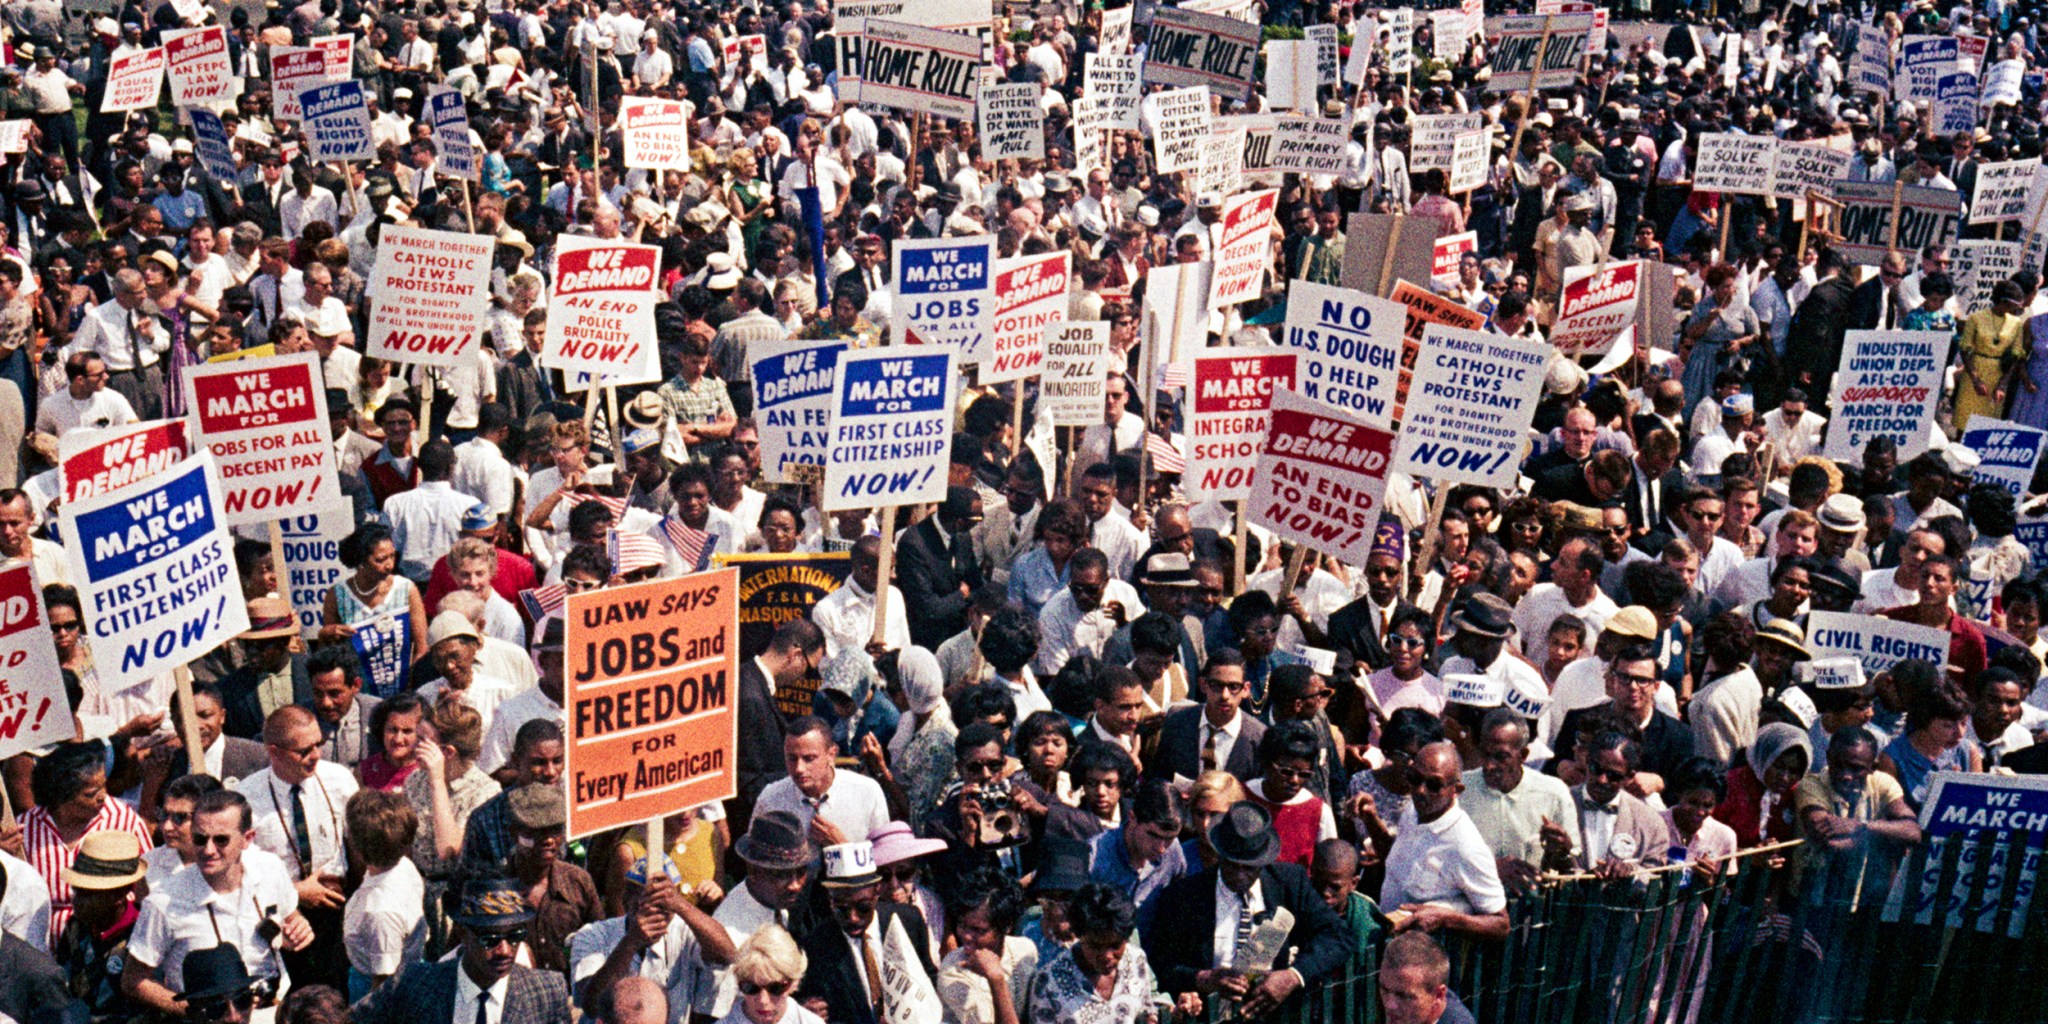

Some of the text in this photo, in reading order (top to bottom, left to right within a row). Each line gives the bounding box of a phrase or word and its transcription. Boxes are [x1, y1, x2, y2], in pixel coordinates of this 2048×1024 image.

[183, 32, 204, 45] WE
[171, 39, 223, 64] DEMAND
[1148, 23, 1254, 81] HOME RULE
[174, 61, 226, 75] AN FEPC
[863, 39, 980, 99] HOME RULE
[187, 73, 219, 83] LAW
[183, 83, 228, 98] NOW!
[318, 86, 341, 99] WE
[983, 88, 1032, 100] FIRST CLASS
[307, 93, 361, 114] DEMAND
[643, 103, 665, 117] WE
[989, 99, 1036, 109] CITIZENS
[314, 117, 361, 128] EQUAL
[629, 113, 682, 127] DEMAND
[986, 110, 1031, 121] CAN VOTE
[316, 128, 366, 141] RIGHTS
[987, 120, 1039, 132] DC WANTS
[1278, 122, 1342, 134] HOME RULE
[634, 130, 681, 142] AN END
[990, 130, 1026, 146] HOME
[320, 141, 369, 155] NOW!
[634, 141, 681, 152] TO BIAS
[1000, 140, 1031, 155] RULE
[1279, 140, 1342, 154] PRIMARY
[1713, 150, 1759, 162] SOLVE
[635, 151, 681, 163] NOW!
[1272, 156, 1342, 170] CIVIL RIGHT
[1717, 163, 1768, 176] PROBLEMS
[1222, 208, 1271, 245] DEMAND
[384, 234, 488, 255] WE MARCH TOGETHER
[1225, 242, 1262, 260] DECENT
[394, 252, 474, 271] CATHOLIC
[589, 250, 626, 269] WE
[932, 249, 959, 264] WE
[408, 267, 456, 281] JEWS
[559, 266, 650, 291] DEMAND
[905, 263, 983, 282] MARCH
[1218, 260, 1262, 279] HOUSING
[386, 277, 475, 296] PROTESTANT
[929, 283, 959, 292] FOR
[1216, 272, 1259, 298] NOW!
[399, 296, 460, 308] FOR DIGNITY
[565, 297, 637, 314] AN END
[908, 299, 980, 320] JOBS
[380, 305, 474, 321] AND BROTHERHOOD
[578, 315, 622, 330] POLICE
[1321, 299, 1372, 331] NO
[376, 316, 476, 332] OF ALL MEN UNDER GOD
[384, 330, 471, 355] NOW!
[564, 325, 630, 344] BRUTALITY
[1059, 328, 1094, 342] JOB
[559, 338, 639, 365] NOW!
[1048, 342, 1105, 356] EQUALITY
[1290, 326, 1396, 371] U.S. DOUGH
[1427, 335, 1544, 365] WE MARCH TOGETHER
[1857, 342, 1933, 356] INDUSTRIAL
[881, 361, 913, 376] WE
[1047, 360, 1095, 378] FOR ALL
[1436, 354, 1526, 382] CATHOLIC
[1850, 358, 1935, 372] UNION DEPT.
[234, 372, 271, 390] WE
[1044, 380, 1102, 396] MINORITIES
[1330, 366, 1379, 391] HELP
[1448, 372, 1503, 392] JEWS
[1858, 374, 1918, 386] AFL-CIO
[850, 376, 940, 401] MARCH
[1423, 382, 1522, 410] PROTESTANT
[1841, 388, 1930, 402] SUPPORTS
[207, 387, 306, 417] MARCH
[876, 401, 912, 412] FOR
[1326, 387, 1385, 416] CROW
[1841, 404, 1924, 417] MARCH FOR
[240, 413, 279, 427] FOR
[1435, 404, 1503, 424] FOR DIGNITY
[838, 419, 944, 442] FIRST CLASS
[1308, 418, 1356, 443] WE
[1413, 413, 1516, 438] AND BROTHERHOOD
[1848, 419, 1917, 431] FREEDOM
[252, 430, 322, 450] FOR ALL
[1406, 426, 1516, 451] OF ALL MEN UNDER GOD
[832, 440, 945, 463] CITIZENSHIP
[1272, 433, 1384, 471] DEMAND
[1410, 442, 1511, 475] NOW!
[222, 453, 324, 478] DECENT PAY
[842, 465, 935, 497] NOW!
[1271, 461, 1373, 510] AN END
[225, 475, 322, 513] NOW!
[126, 489, 169, 521] WE
[1271, 479, 1366, 529] TO BIAS
[94, 495, 205, 562] MARCH
[1265, 503, 1362, 549] NOW!
[135, 538, 182, 564] FOR
[93, 540, 223, 613] FIRST CLASS
[94, 563, 229, 637] CITIZENSHIP
[583, 585, 720, 628] UAW SAYS
[121, 594, 227, 673] NOW!
[575, 626, 726, 683] JOBS and
[1814, 629, 1943, 666] CIVIL RIGHTS
[575, 670, 727, 739] FREEDOM
[1507, 689, 1543, 714] UAW
[632, 733, 676, 756] FOR
[576, 747, 723, 801] Every American
[1986, 792, 2022, 807] WE
[1940, 805, 2048, 831] MARCH
